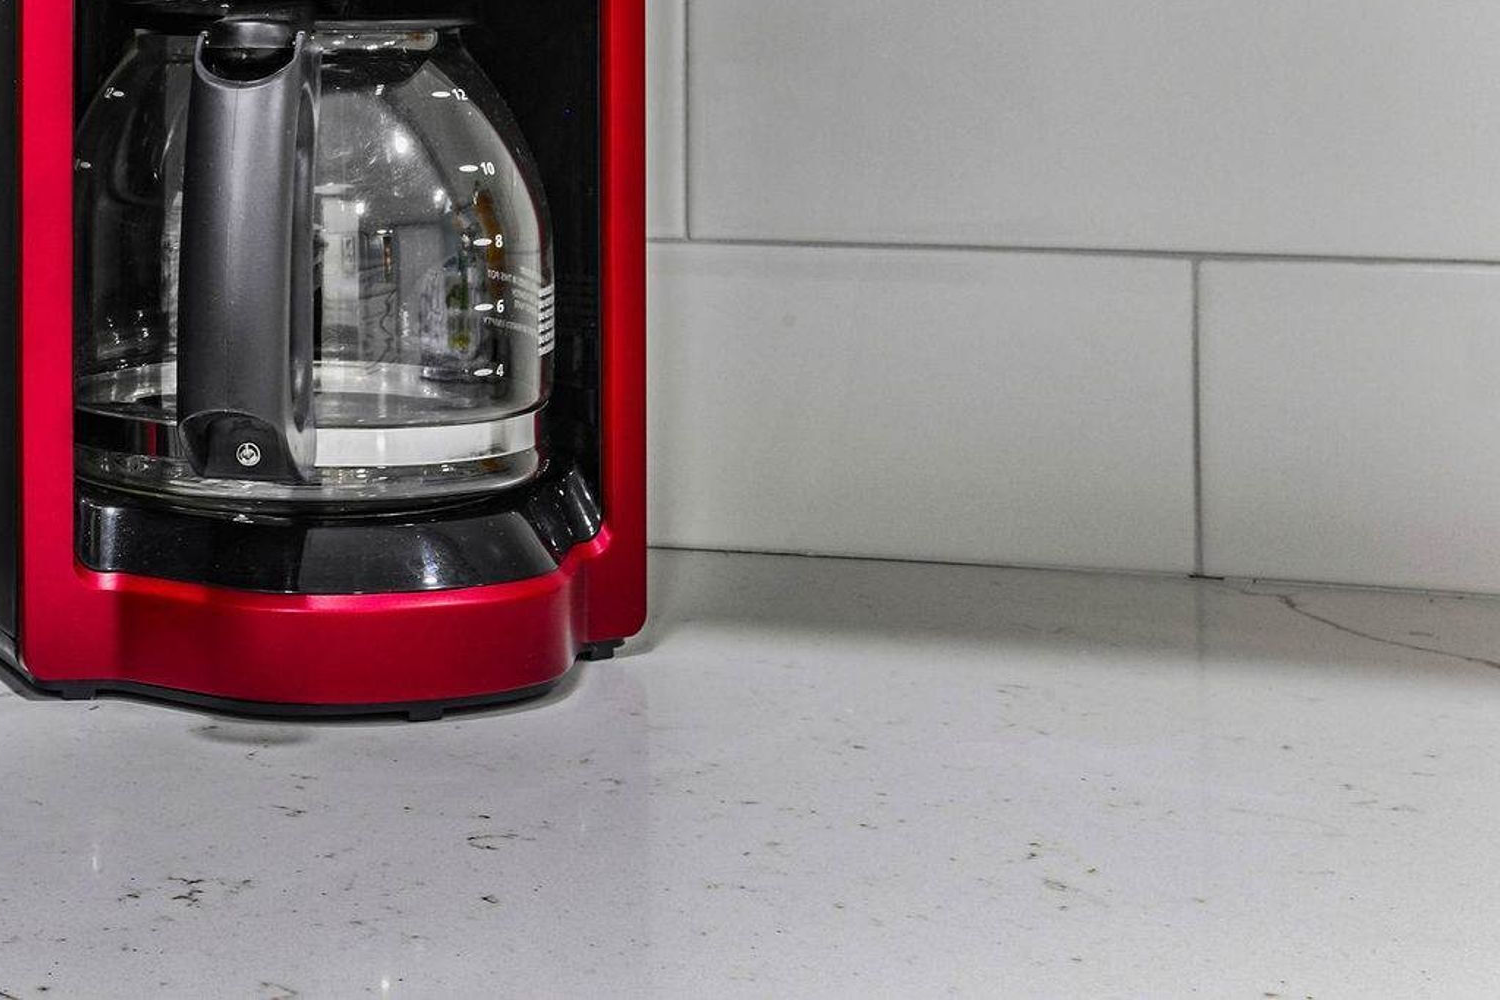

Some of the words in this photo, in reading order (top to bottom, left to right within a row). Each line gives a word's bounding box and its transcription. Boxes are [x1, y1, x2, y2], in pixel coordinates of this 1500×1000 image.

[451, 88, 469, 101] 12
[480, 162, 495, 176] 10
[495, 235, 503, 249] 8
[496, 299, 505, 314] 6
[496, 363, 504, 377] 4
